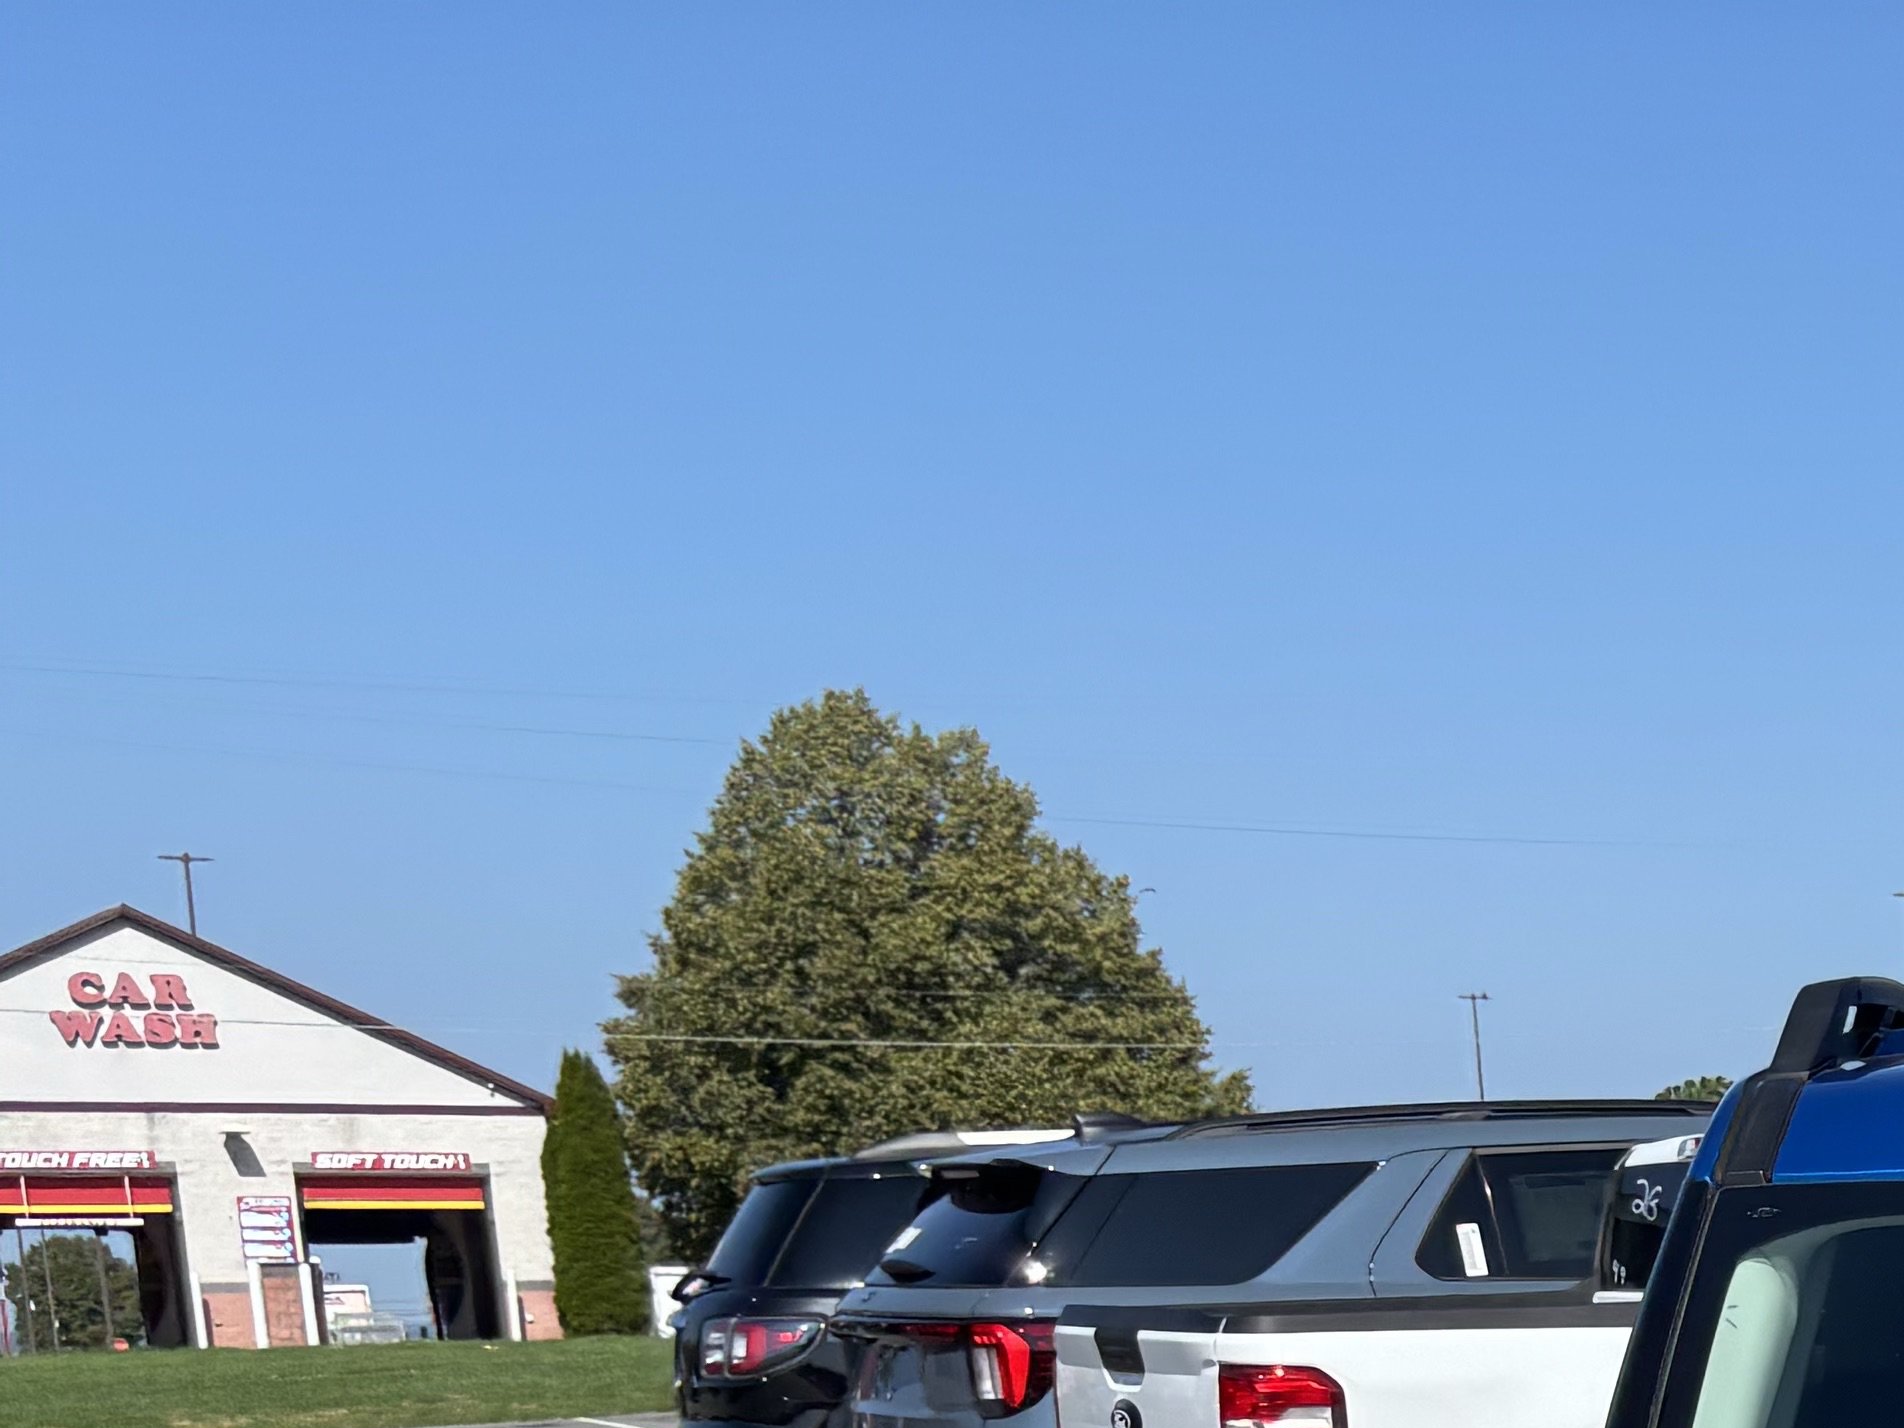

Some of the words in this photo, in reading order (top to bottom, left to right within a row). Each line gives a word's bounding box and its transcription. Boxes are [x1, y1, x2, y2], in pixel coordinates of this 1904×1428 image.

[67, 971, 195, 1010] CAR
[48, 1010, 220, 1049] WASH
[314, 1153, 378, 1168] SOFT
[1631, 1178, 1663, 1221] 26
